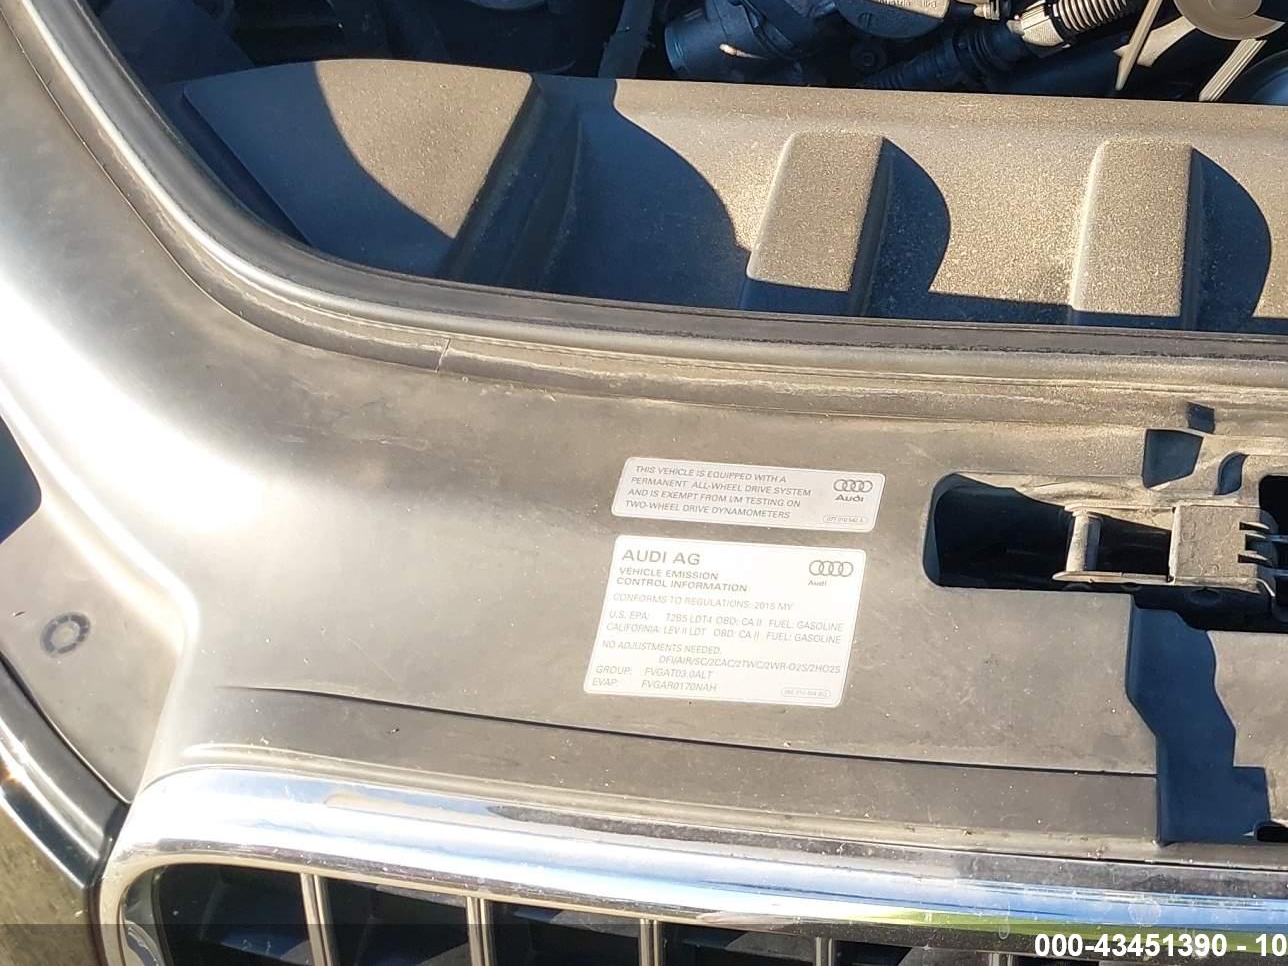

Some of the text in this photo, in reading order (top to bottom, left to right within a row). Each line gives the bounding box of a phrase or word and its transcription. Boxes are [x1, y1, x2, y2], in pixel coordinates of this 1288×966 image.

[636, 466, 656, 474] THIS
[658, 467, 694, 476] VEHICLE
[707, 470, 752, 480] EQUIPPED
[754, 474, 778, 482] WITH
[632, 476, 811, 496] PERMANENT ALL-WHEEL DRIVE SYSTEM
[661, 490, 698, 500] EXEMPT
[700, 494, 726, 502] FROM
[728, 495, 743, 503] I/M
[745, 497, 784, 506] TESTING
[834, 494, 864, 502] Audi
[625, 500, 791, 519] TWO-WHEEL DRIVE DYNAMOMETERS
[622, 550, 700, 565] AUDI AG
[619, 567, 719, 580] VEHICLE EMISSION
[616, 577, 748, 592] CONTROL INFORMATION
[613, 593, 667, 604] CONFORMS
[670, 595, 682, 604] TO
[754, 602, 776, 610] 2015
[777, 602, 794, 611] MY
[609, 610, 626, 619] U.S.
[742, 617, 754, 626] CA
[796, 620, 844, 631] GASOLINE
[663, 626, 678, 634] LEV
[689, 627, 706, 636] LDT
[738, 630, 751, 639] CA
[795, 633, 841, 644] GASOLINE
[602, 640, 616, 649] NO
[618, 641, 682, 653] ADJUSTMENTS
